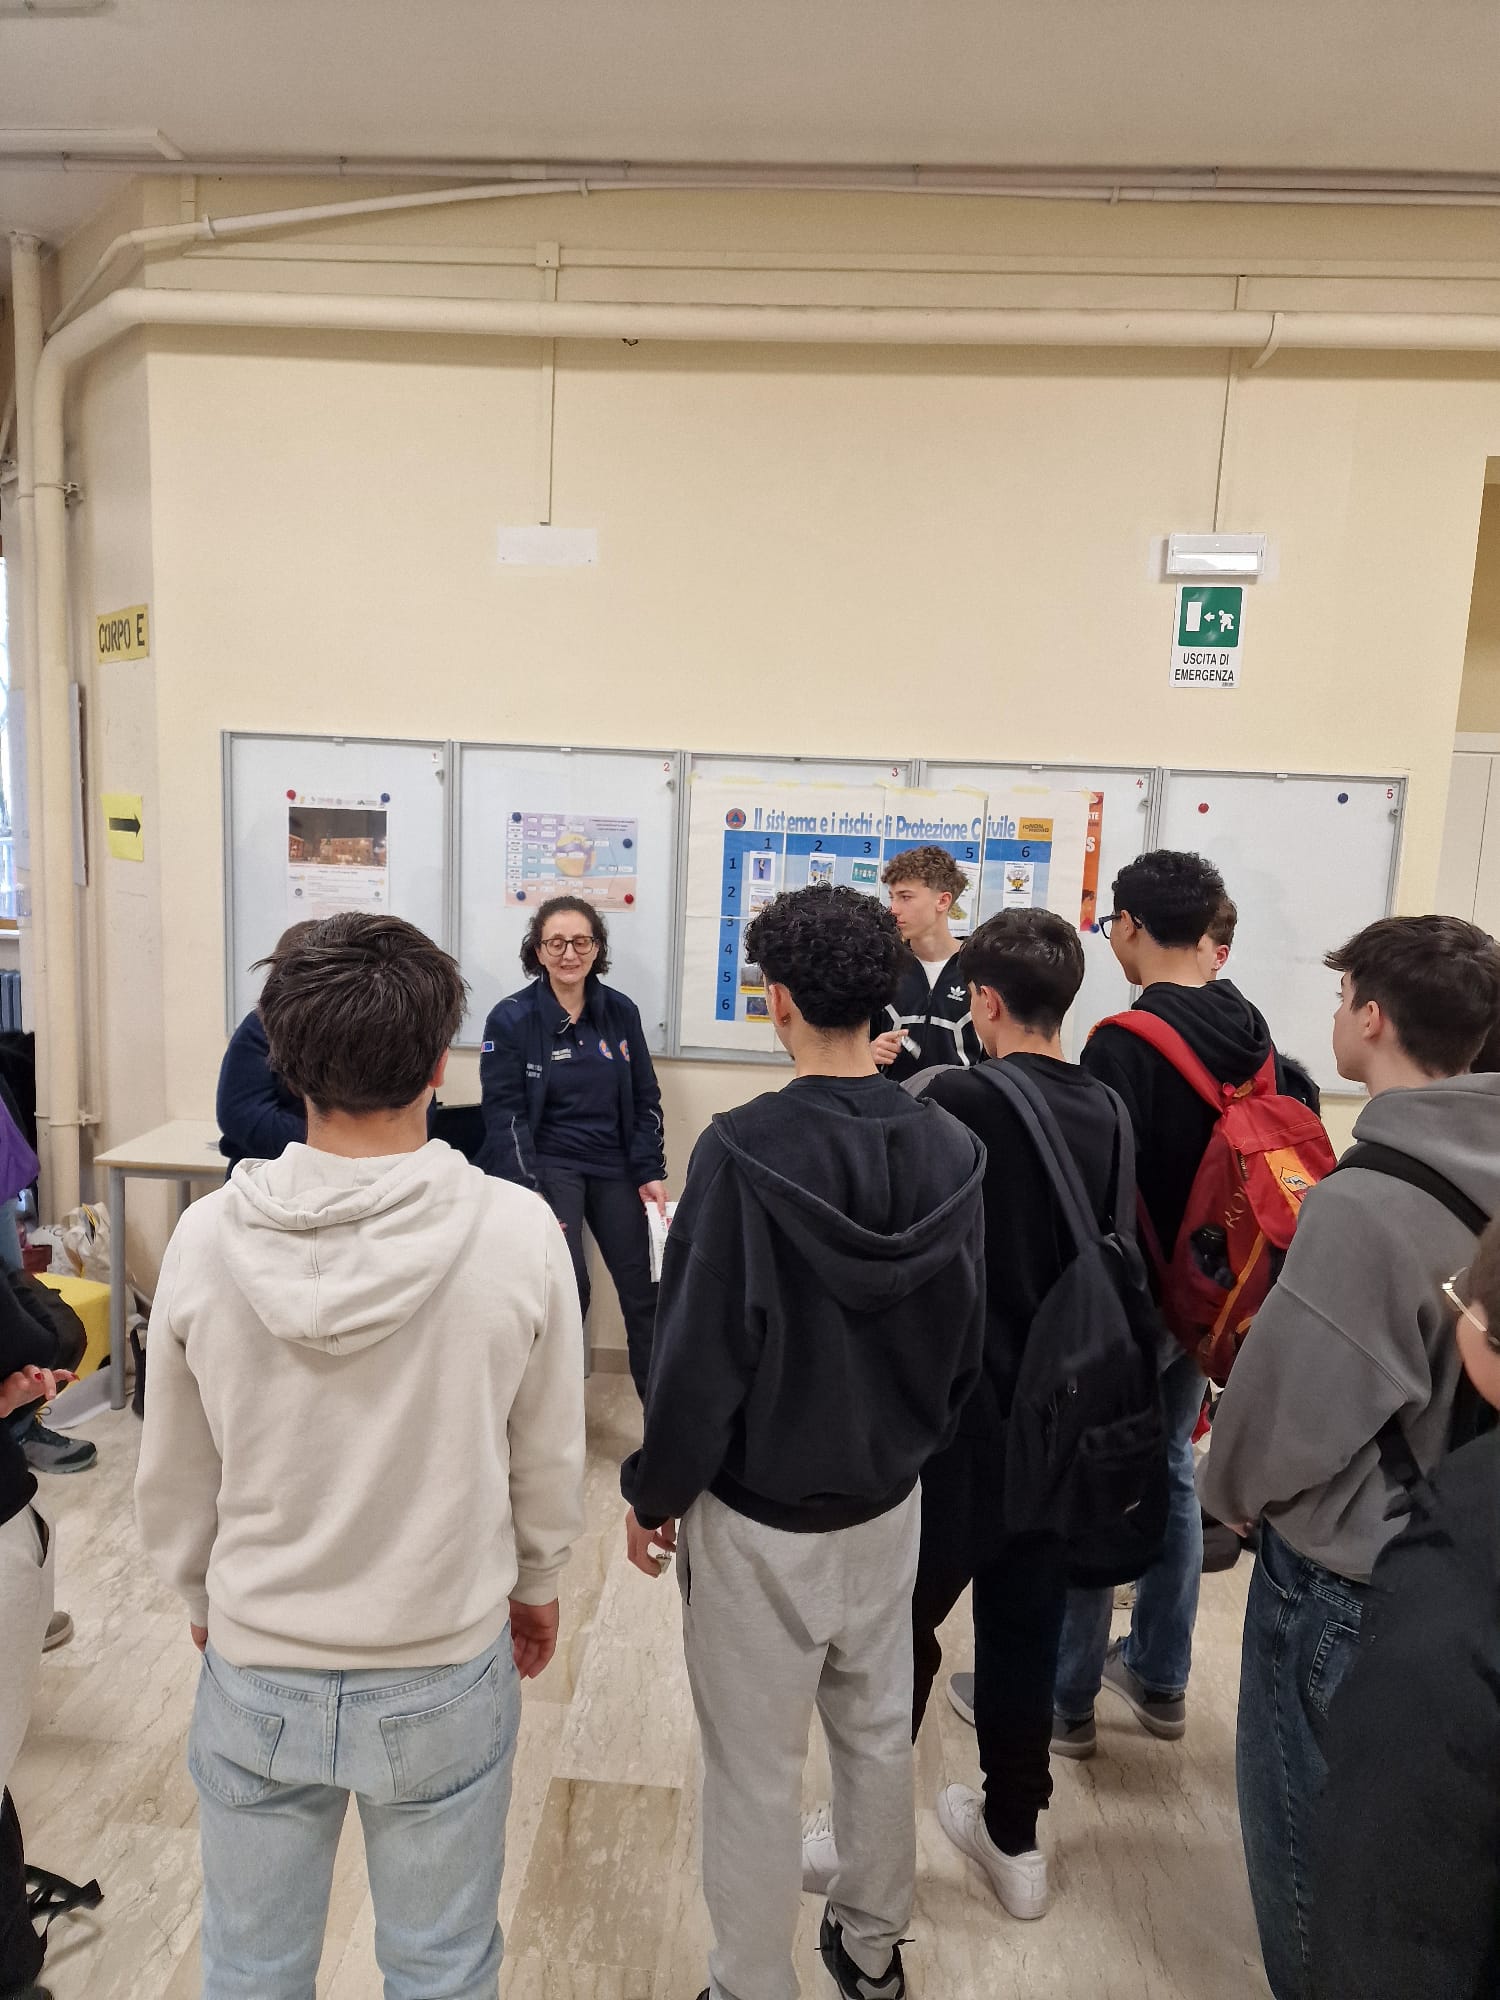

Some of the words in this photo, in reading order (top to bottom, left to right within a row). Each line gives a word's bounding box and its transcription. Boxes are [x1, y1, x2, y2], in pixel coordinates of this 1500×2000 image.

[99, 619, 131, 653] CORPO
[137, 613, 145, 646] E
[1183, 653, 1217, 665] USCITA
[1219, 654, 1230, 665] DI
[1174, 669, 1234, 681] EMERGENZA
[663, 762, 671, 771] 2
[892, 767, 899, 777] 3
[1136, 778, 1144, 788] 4
[1386, 788, 1394, 799] 5
[754, 807, 763, 830] Il
[766, 809, 817, 833] sistema
[820, 817, 828, 833] e
[831, 811, 836, 833] i
[839, 811, 873, 835] rischi
[876, 814, 893, 838] di
[896, 815, 968, 840] Protezione
[971, 815, 1016, 840] Civile
[764, 837, 772, 850] 1
[815, 840, 823, 852] 2
[863, 841, 872, 853] 3
[965, 847, 974, 859] 5
[1021, 846, 1030, 858] 6
[729, 857, 737, 869] 1
[727, 886, 735, 898] 2
[726, 915, 734, 927] 3
[724, 943, 733, 956] 4
[723, 971, 731, 983] 5
[721, 998, 730, 1010] 6
